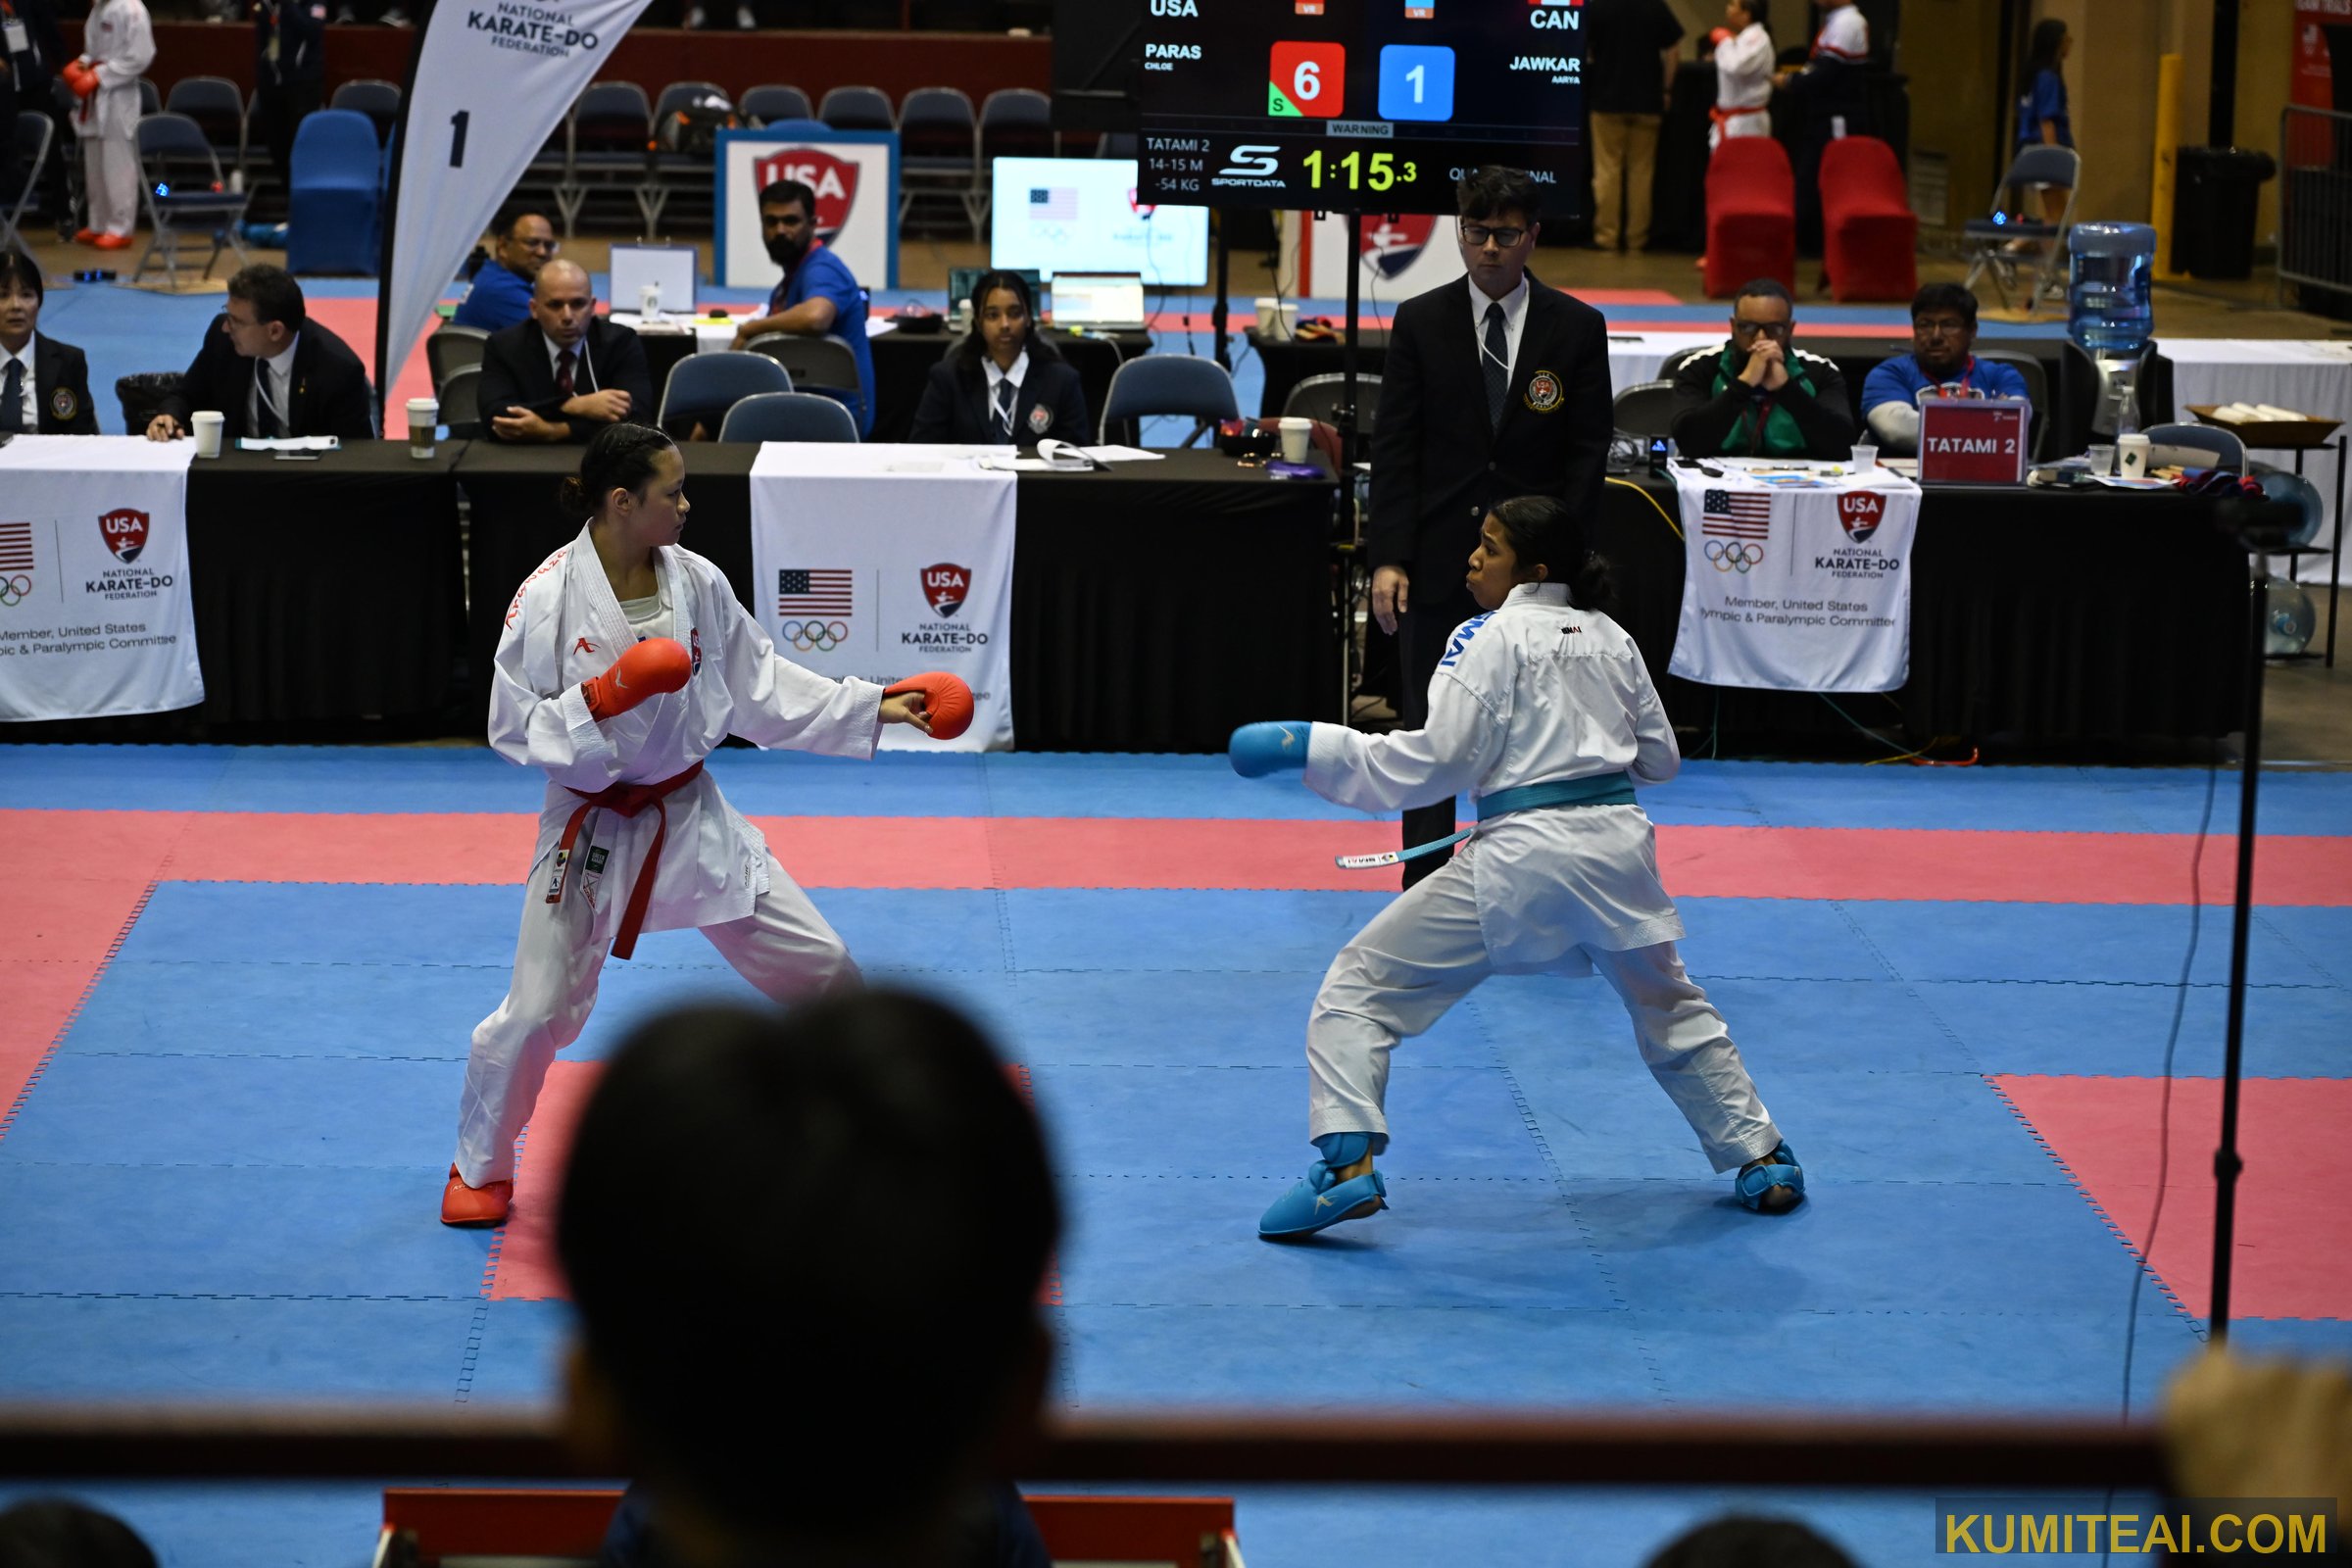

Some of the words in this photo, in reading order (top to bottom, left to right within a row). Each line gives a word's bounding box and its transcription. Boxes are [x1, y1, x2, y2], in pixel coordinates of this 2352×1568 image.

[497, 2, 575, 26] NATIONAL
[1150, 0, 1199, 18] USA
[1530, 10, 1580, 30] CAN
[466, 10, 599, 50] KARATE-DO
[491, 35, 569, 58] FEDERATION
[1145, 43, 1202, 60] PARAS
[1145, 62, 1174, 72] CHLOE
[1509, 56, 1581, 73] JAWKAR
[1294, 60, 1321, 101] 6
[1405, 64, 1425, 104] 1
[1551, 74, 1581, 85] AARYA
[1272, 98, 1285, 112] S
[1332, 123, 1390, 135] WARNING
[450, 109, 470, 169] 1
[1147, 137, 1198, 152] TATAMI
[1201, 139, 1210, 152] 2
[1149, 158, 1186, 172] 14-15
[1190, 159, 1203, 172] M
[1154, 178, 1177, 191] -54
[1180, 179, 1200, 192] KG
[1211, 177, 1287, 188] SPORTDATA
[1927, 437, 1997, 454] TATAMI
[2004, 438, 2016, 455] 2
[1843, 497, 1879, 514] USA
[105, 516, 143, 534] USA
[1833, 548, 1884, 558] NATIONAL
[1815, 557, 1899, 570] KARATE-DO
[102, 567, 154, 579] NATIONAL
[927, 571, 964, 588] USA
[1832, 570, 1884, 579] FEDERATION
[85, 575, 173, 594] KARATE-DO
[104, 590, 158, 601] FEDERATION
[1725, 596, 1779, 611] Member,
[1783, 599, 1824, 612] United
[1828, 601, 1868, 612] States
[918, 622, 971, 632] NATIONAL
[1744, 612, 1754, 623] &
[1756, 613, 1826, 627] Paralympic
[58, 625, 101, 639] United
[104, 622, 146, 636] States
[902, 632, 989, 645] KARATE-DO
[19, 644, 29, 656] &
[32, 639, 106, 655] Paralympic
